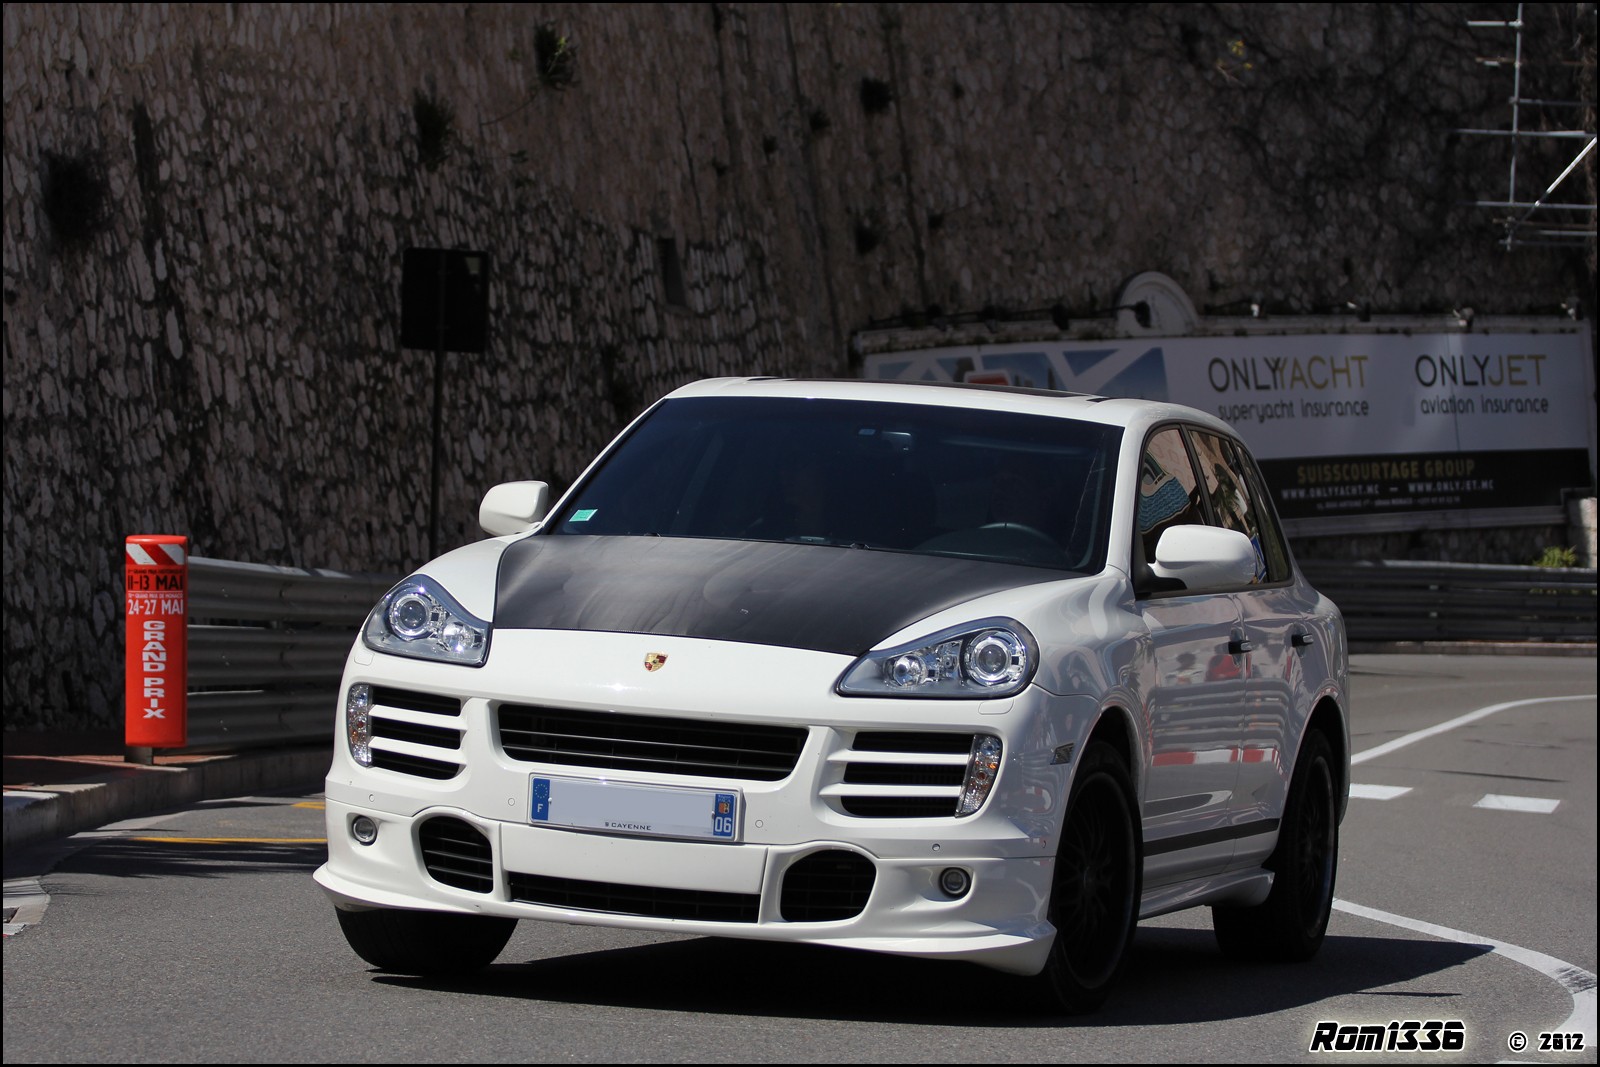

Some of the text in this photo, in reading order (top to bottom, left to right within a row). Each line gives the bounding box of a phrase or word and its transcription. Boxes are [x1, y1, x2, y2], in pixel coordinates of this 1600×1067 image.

[1415, 354, 1547, 387] ONLYJET
[1218, 398, 1369, 423] superyacht insurance
[1421, 394, 1549, 415] aviation insurance
[1297, 459, 1475, 484] SUISSCOURTAGE GROUP
[156, 575, 184, 590] MAI
[128, 599, 184, 615] 24-27 MAI
[142, 620, 167, 672] GRAND
[143, 677, 166, 718] PRIX
[537, 803, 544, 813] F
[611, 822, 652, 831] CAYENNE
[714, 816, 732, 833] 06
